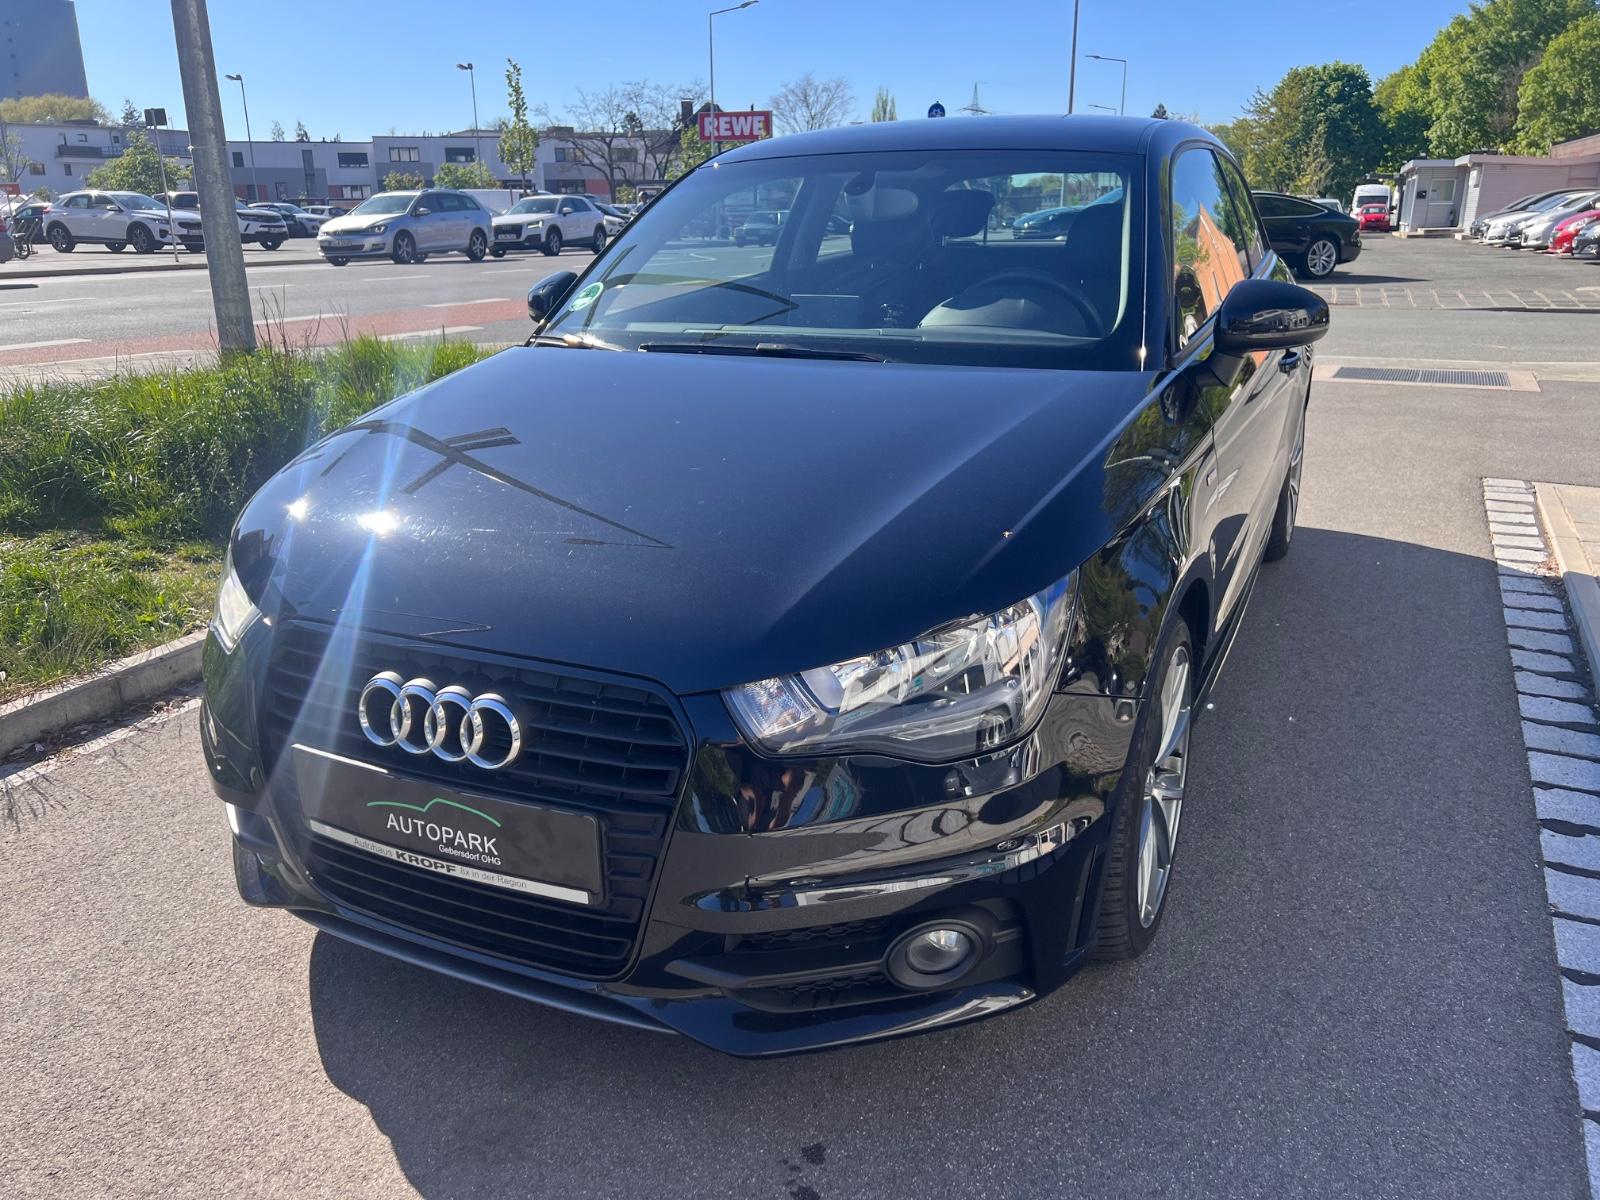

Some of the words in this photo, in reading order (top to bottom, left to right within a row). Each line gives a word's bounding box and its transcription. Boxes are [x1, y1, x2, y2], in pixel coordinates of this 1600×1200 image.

[703, 116, 765, 137] REWE
[387, 813, 499, 855] AUTOPARK
[353, 837, 394, 857] Autohaus
[395, 850, 457, 873] KROPF
[482, 873, 495, 882] der
[497, 876, 528, 889] Region
[438, 844, 480, 862] Gebersdorf
[481, 857, 502, 867] OHG
